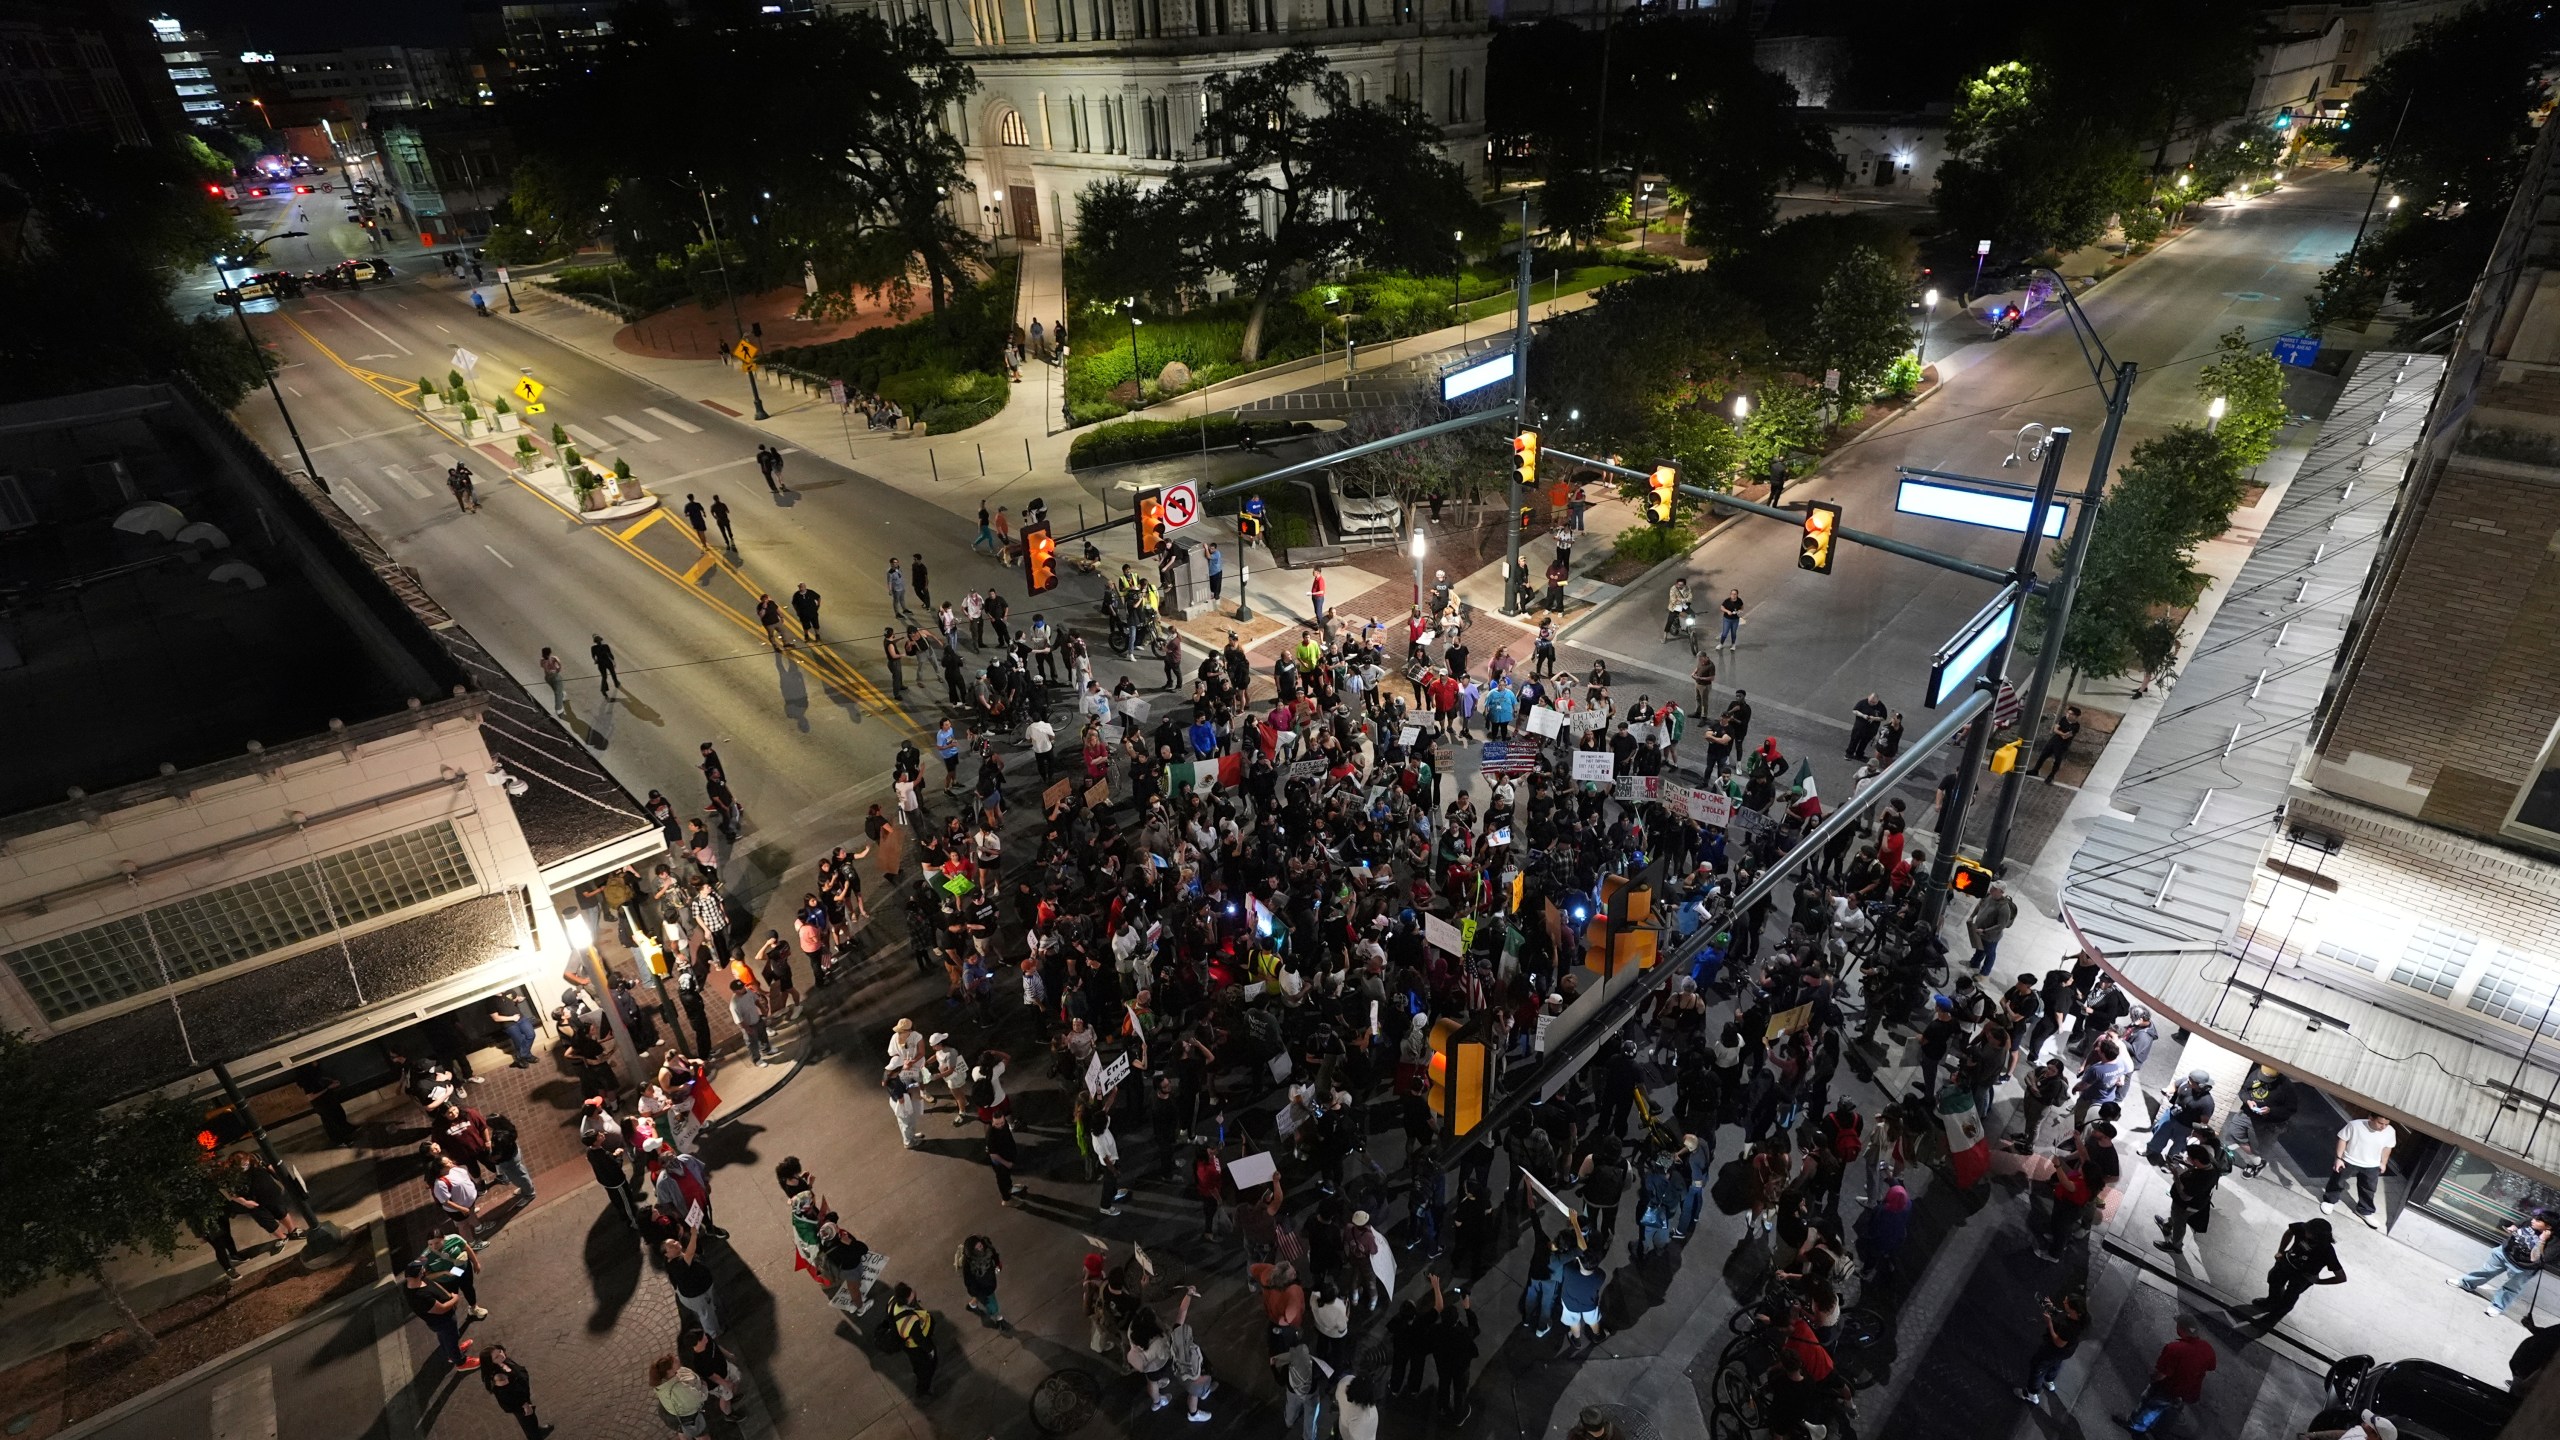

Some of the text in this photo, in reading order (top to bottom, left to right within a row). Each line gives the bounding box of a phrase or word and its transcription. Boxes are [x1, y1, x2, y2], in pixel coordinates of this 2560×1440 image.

[1572, 711, 1605, 720] CHINGA
[1296, 761, 1313, 769] FUCK
[1666, 783, 1690, 797] NO ON
[1693, 791, 1724, 804] NO ONE
[1702, 806, 1725, 816] STOLEN
[1107, 1055, 1126, 1077] End
[861, 1253, 884, 1265] STOP
